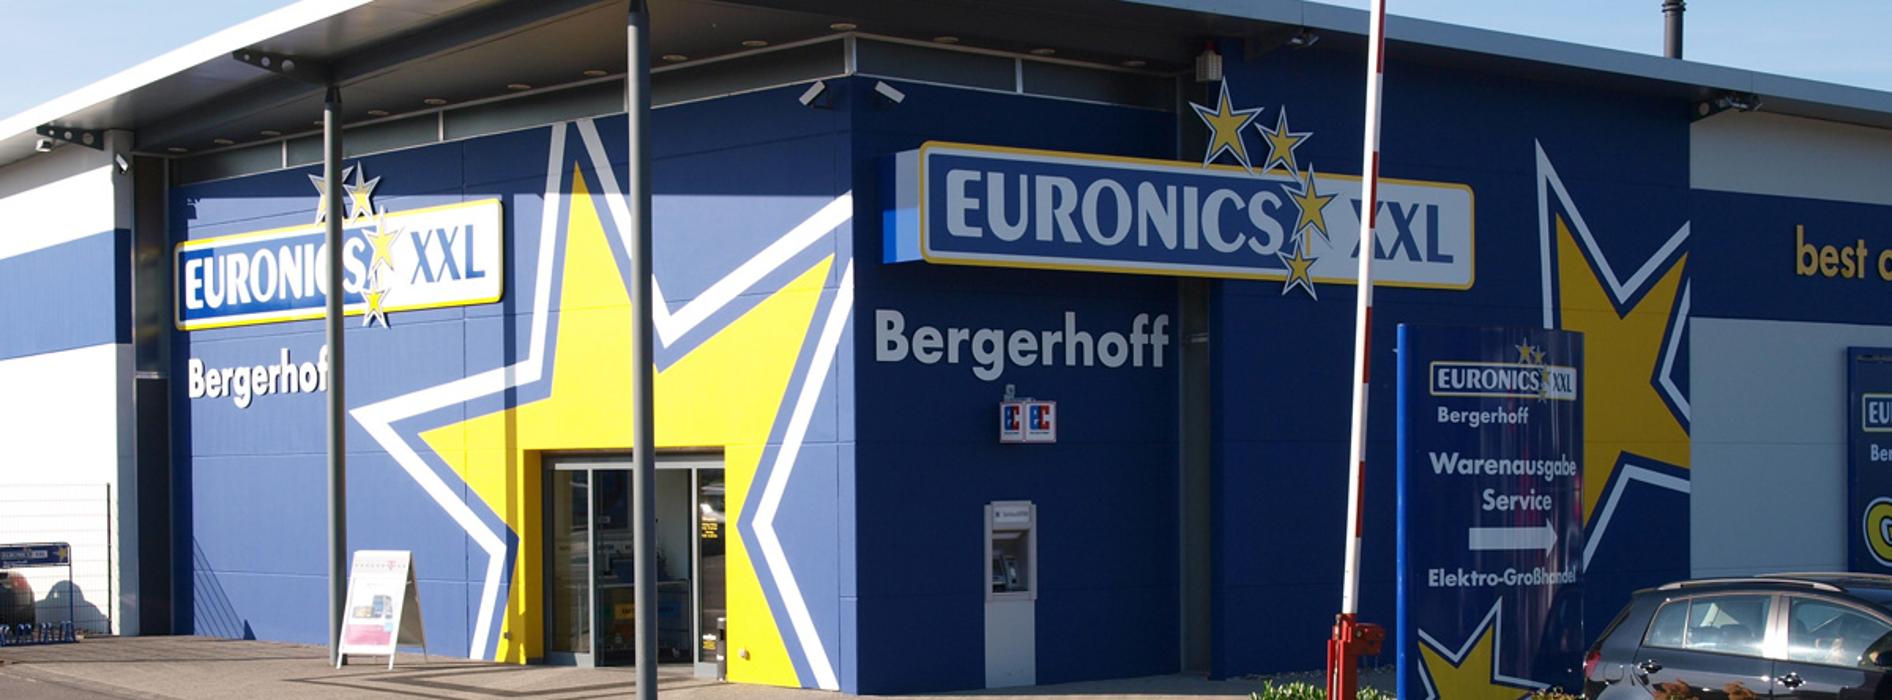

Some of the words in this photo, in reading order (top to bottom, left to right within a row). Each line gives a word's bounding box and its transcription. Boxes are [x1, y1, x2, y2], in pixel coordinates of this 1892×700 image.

[945, 168, 1286, 255] EURONICS
[1350, 199, 1454, 263] XXL
[410, 225, 486, 285] XXL
[1796, 224, 1868, 279] best
[875, 309, 1169, 381] Bergerhoff
[188, 345, 328, 409] Bergerhof
[1437, 368, 1540, 392] EURONICS
[1553, 373, 1573, 393] XXL
[1437, 406, 1529, 428] Bergerhoff
[1429, 452, 1577, 482] Warenausgabe
[1482, 488, 1552, 512] Service
[1428, 568, 1576, 588] Elektro-Großhandel
